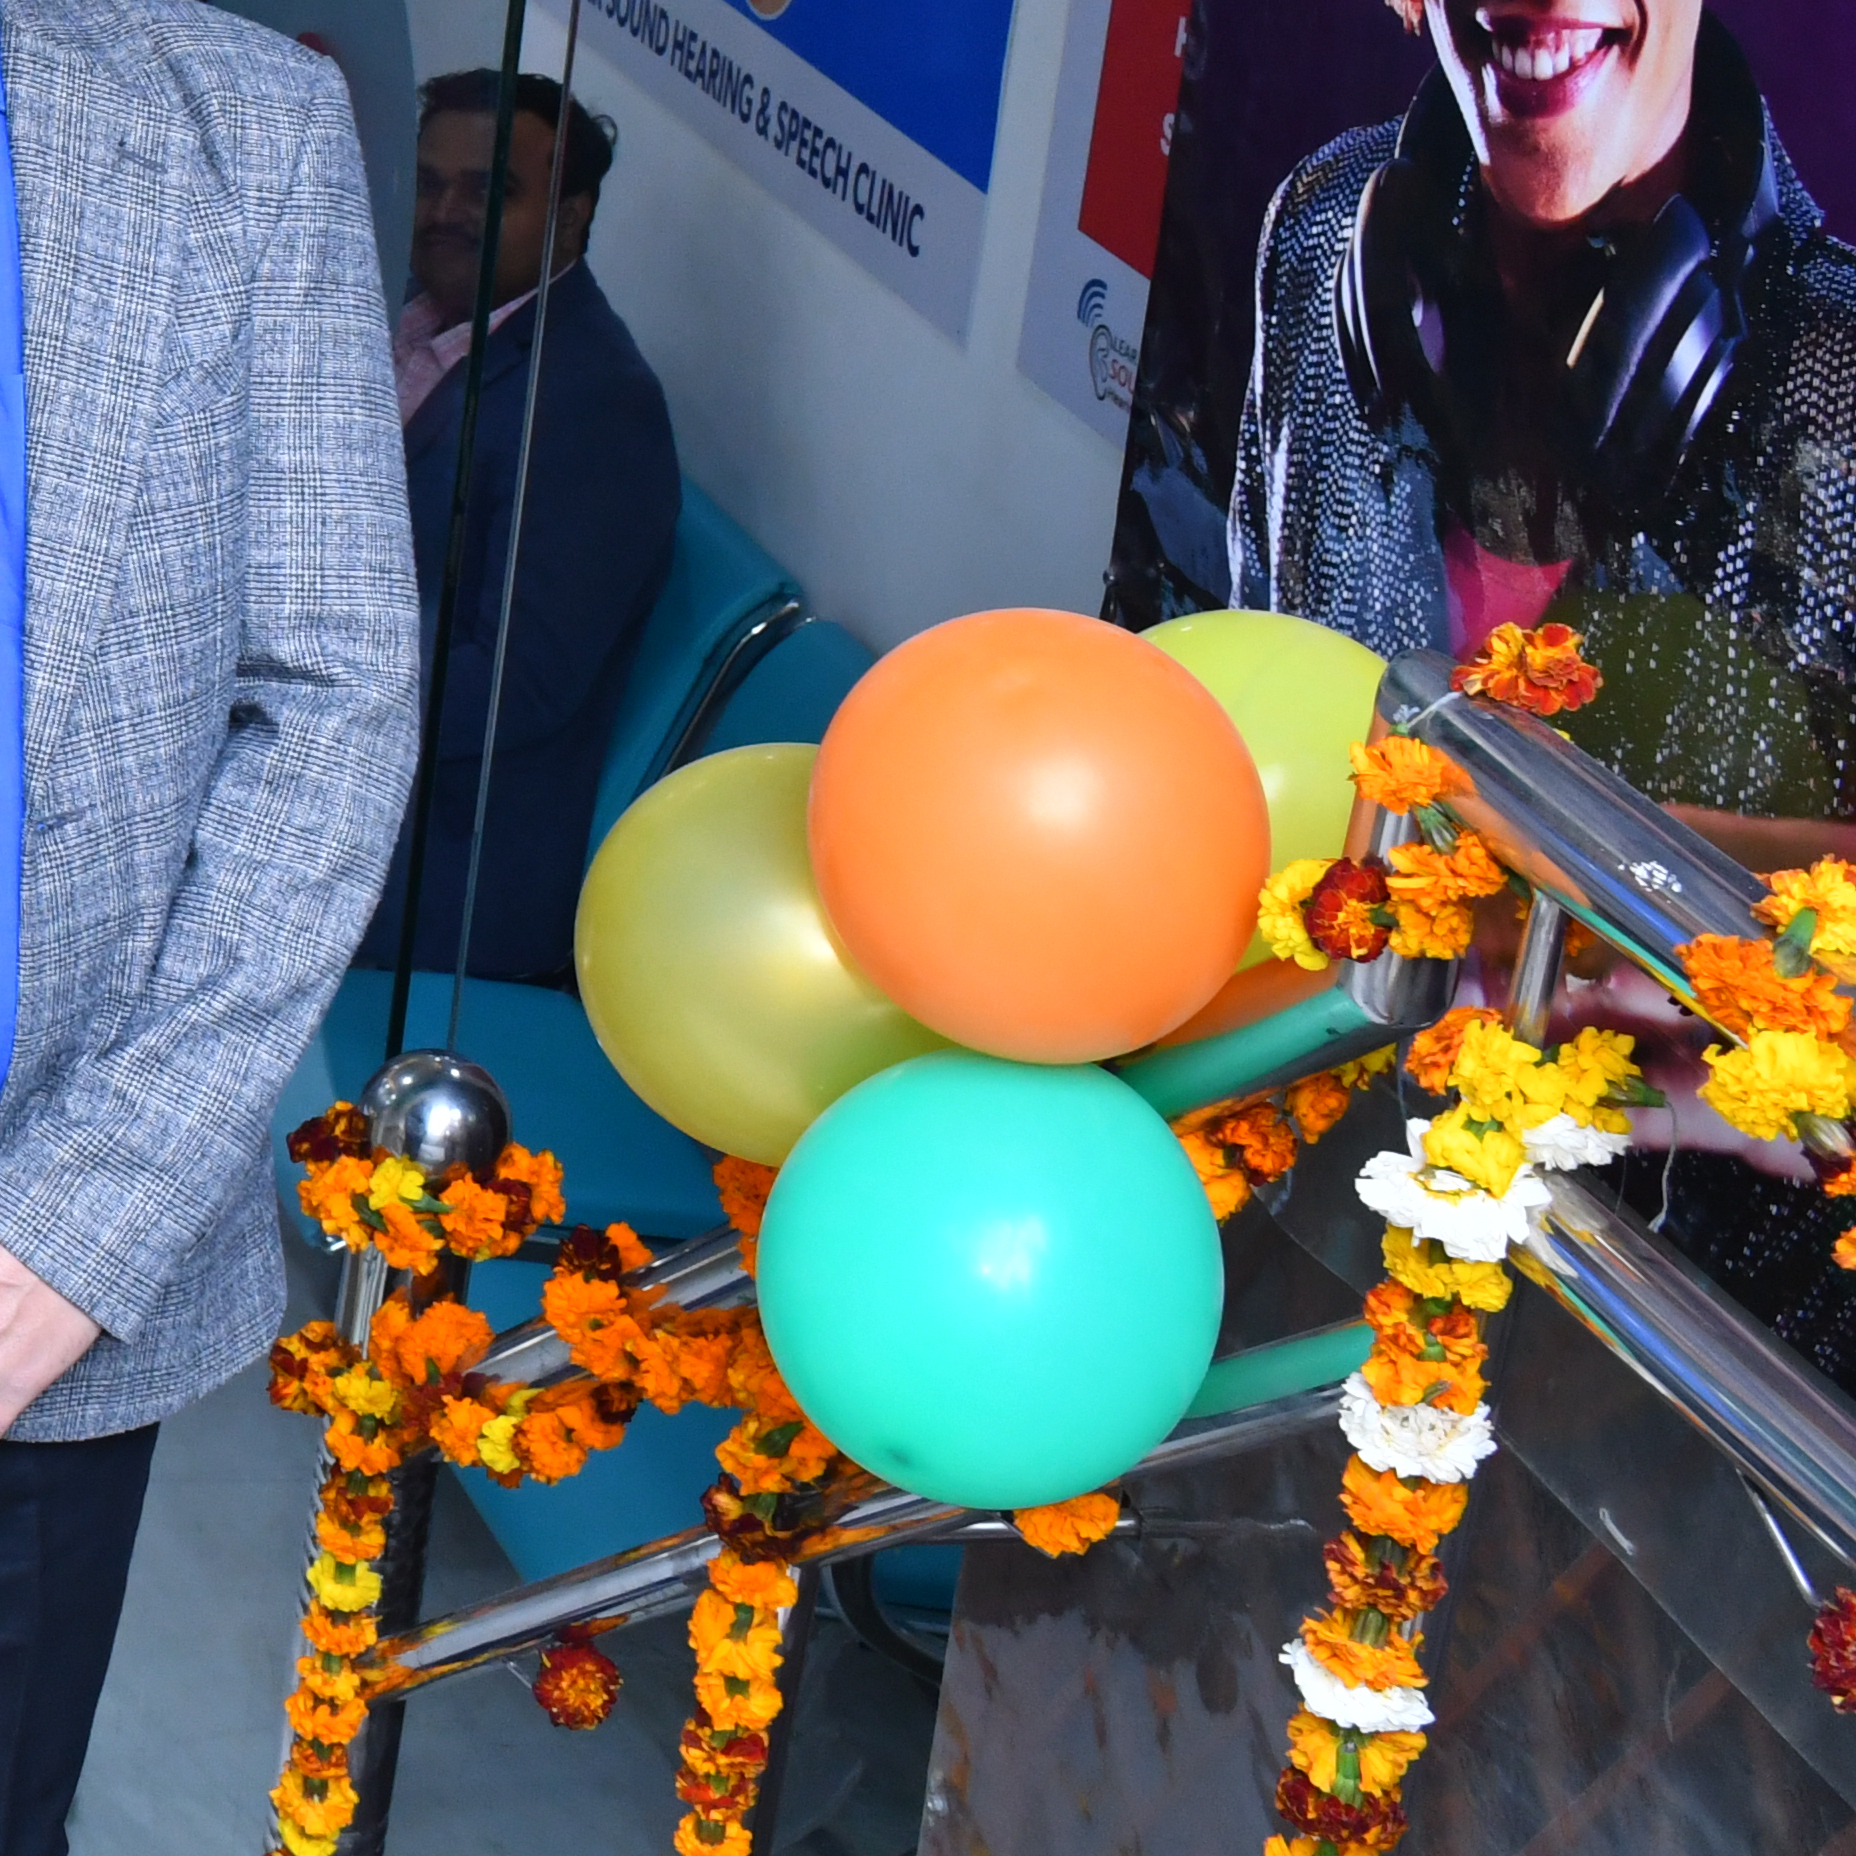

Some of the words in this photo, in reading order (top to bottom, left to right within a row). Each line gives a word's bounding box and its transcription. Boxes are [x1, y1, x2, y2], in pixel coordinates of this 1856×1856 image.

[670, 19, 755, 124] HEARING
[755, 87, 770, 141] &
[773, 100, 852, 202] SPEECH
[852, 162, 926, 258] CLINIC
